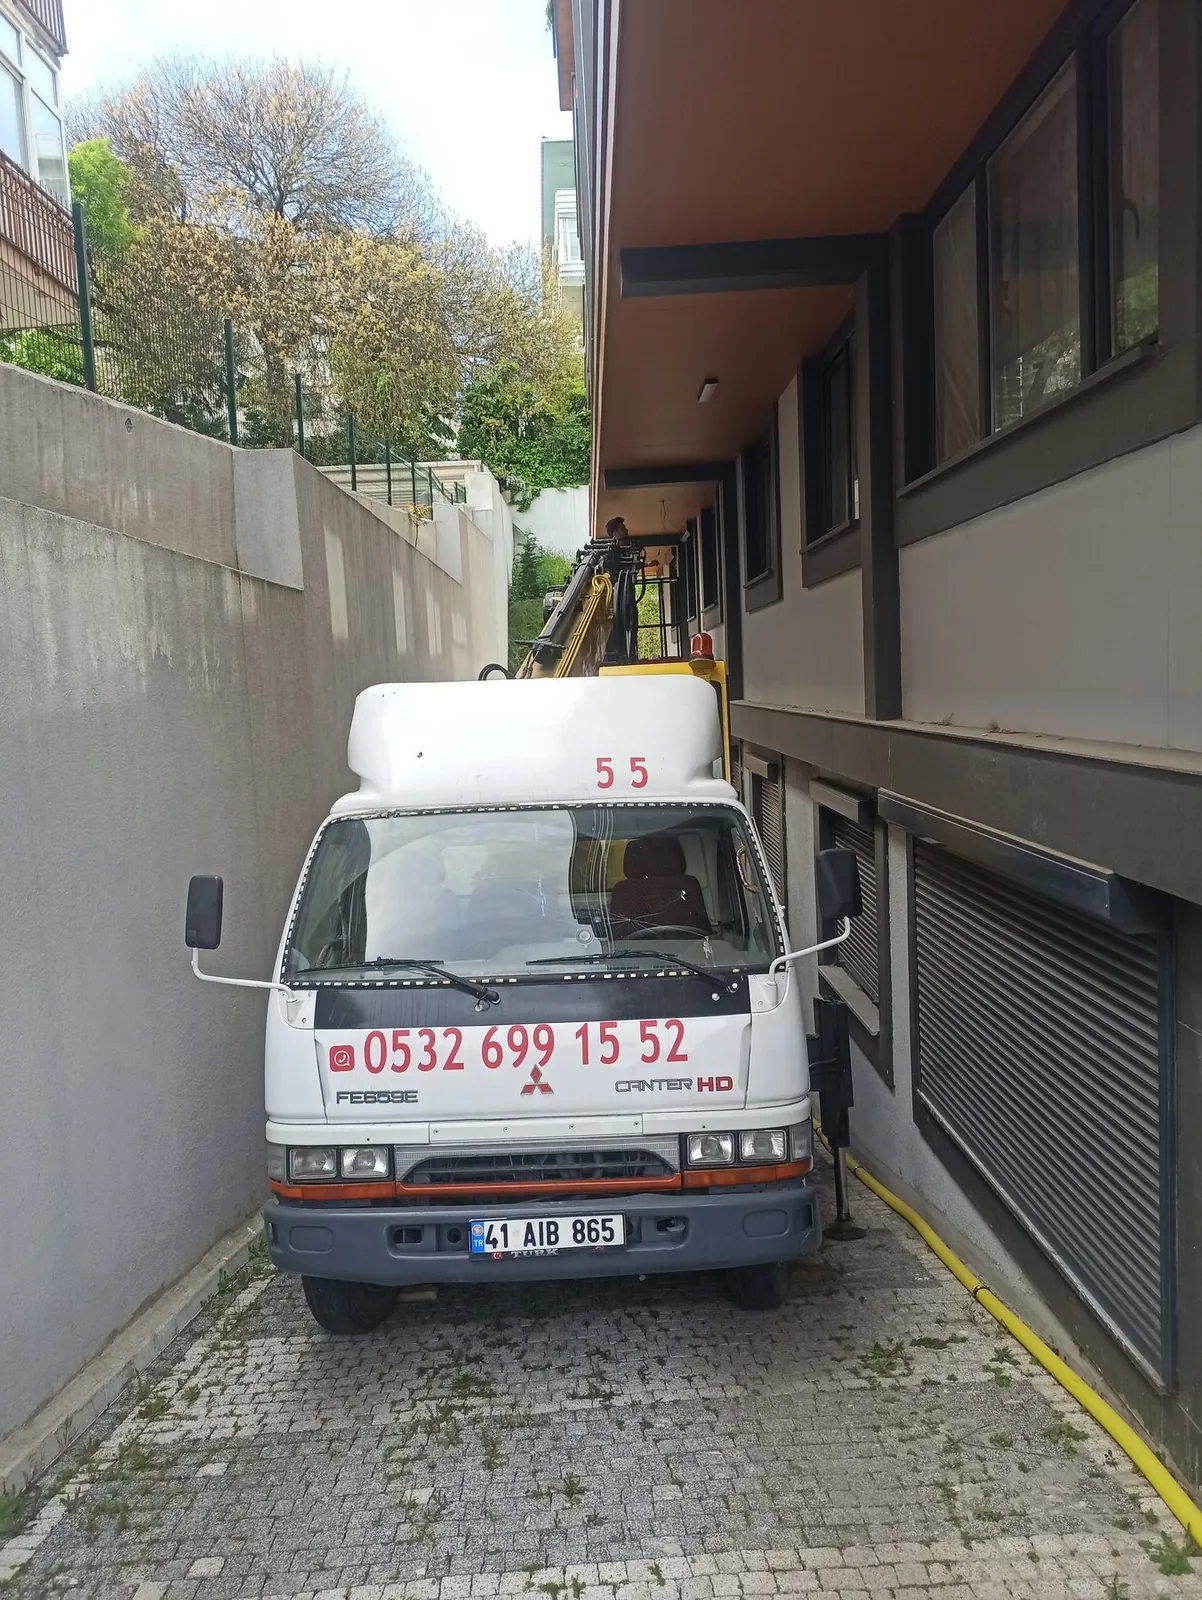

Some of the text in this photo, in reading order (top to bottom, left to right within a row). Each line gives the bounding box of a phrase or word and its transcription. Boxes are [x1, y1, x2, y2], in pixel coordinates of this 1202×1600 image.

[364, 1019, 688, 1073] 0532 699 15 52
[614, 1076, 733, 1093] CANTER HD
[336, 1090, 418, 1104] FE659E
[485, 1218, 615, 1249] 41 AIB 865
[473, 1239, 484, 1247] TR
